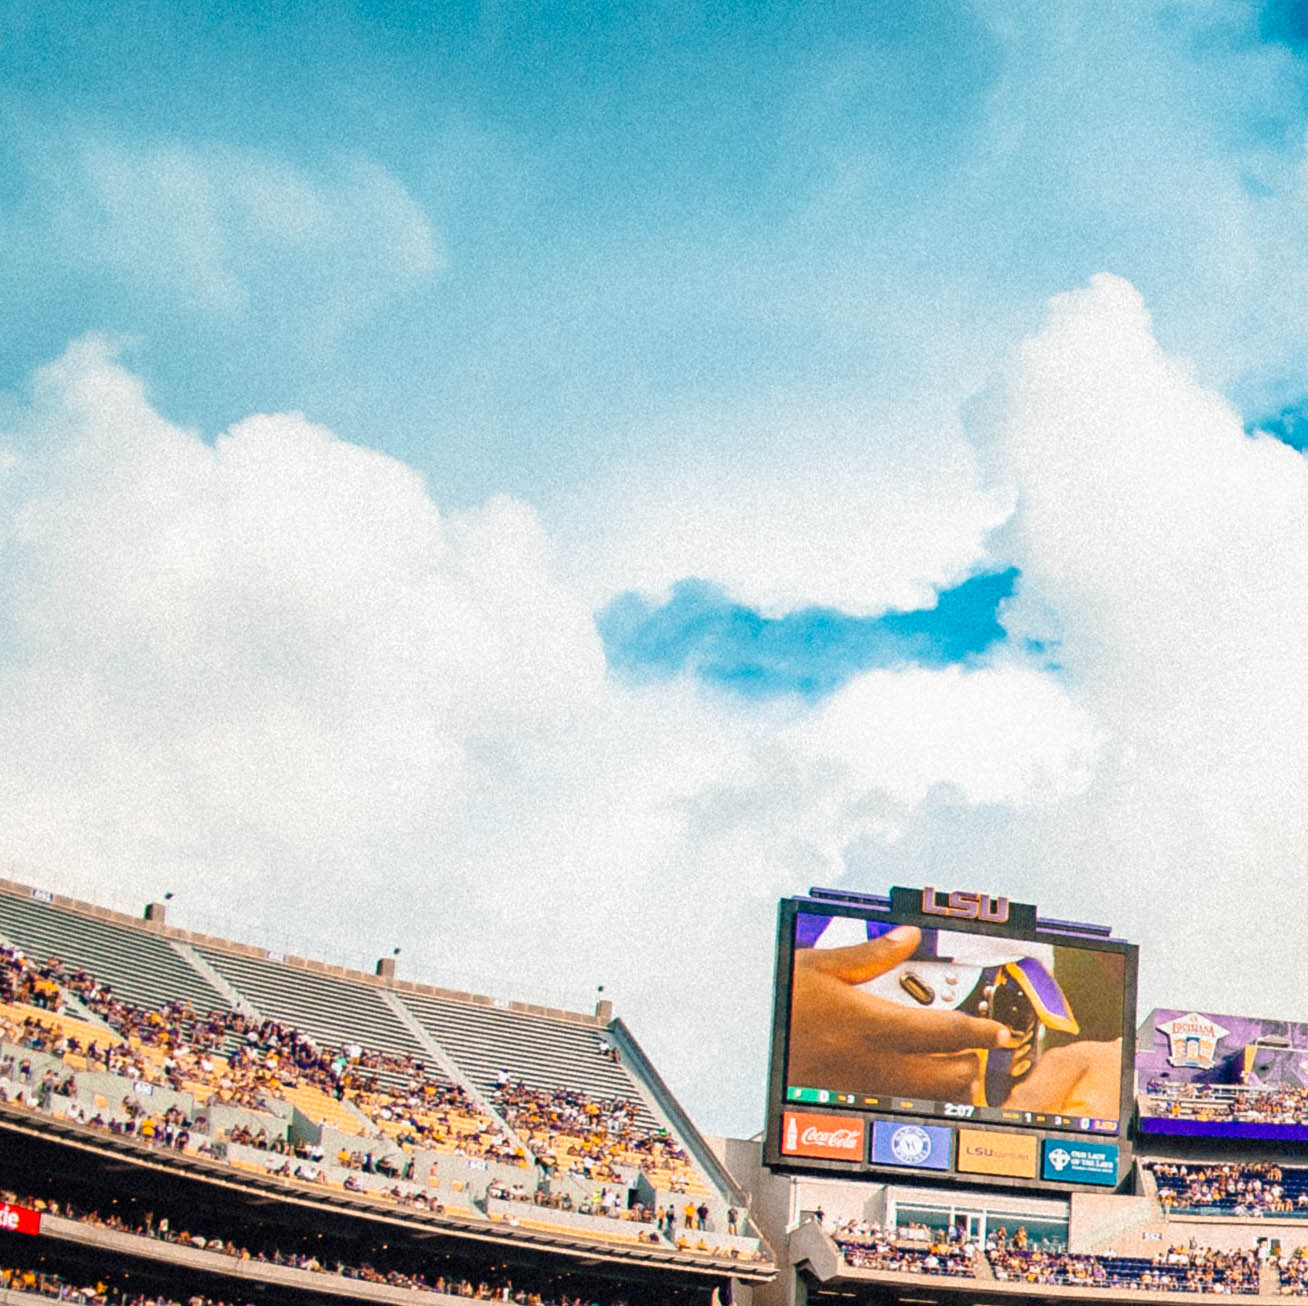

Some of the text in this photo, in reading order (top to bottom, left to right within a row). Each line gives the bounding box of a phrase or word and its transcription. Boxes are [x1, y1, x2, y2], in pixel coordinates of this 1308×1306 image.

[921, 886, 1010, 923] LSU
[944, 1102, 976, 1118] 2:07
[801, 1126, 861, 1149] Coca-Cola
